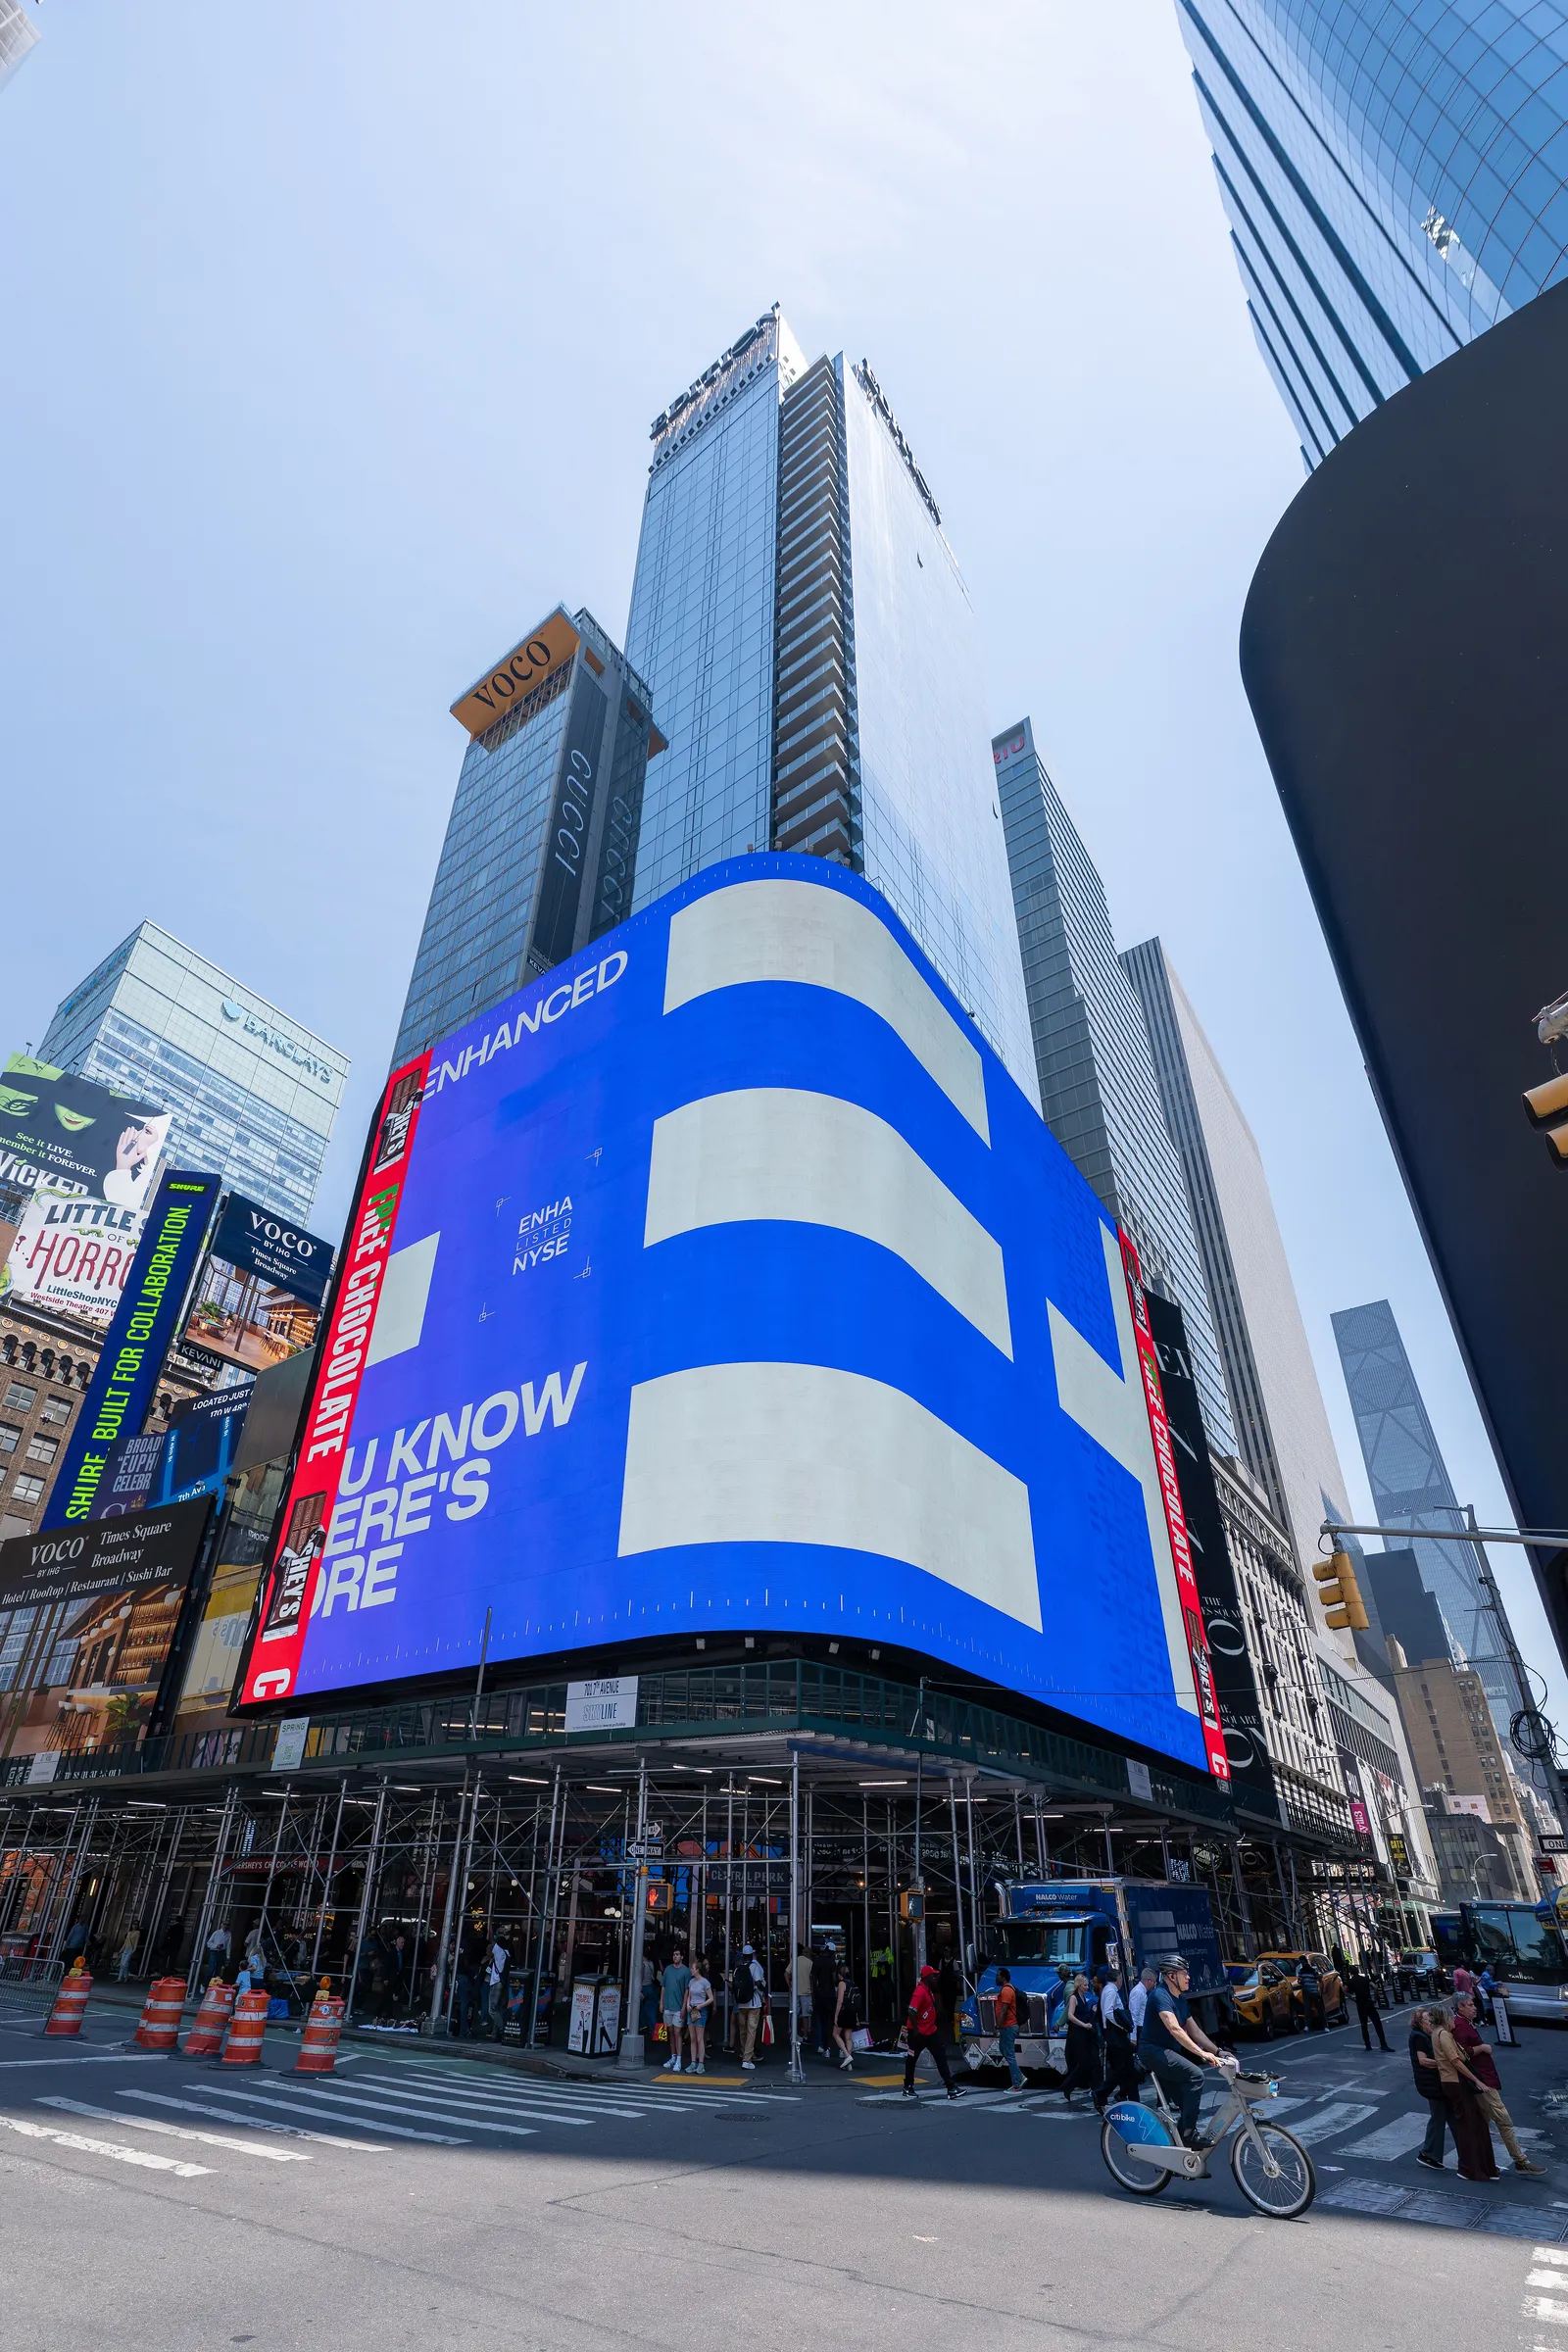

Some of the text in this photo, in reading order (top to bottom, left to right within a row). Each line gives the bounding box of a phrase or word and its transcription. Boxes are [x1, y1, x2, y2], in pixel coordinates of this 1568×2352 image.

[471, 639, 552, 710] VOCO
[555, 749, 593, 877] GUCCI
[423, 950, 629, 1102] ENHANCED
[241, 1011, 335, 1085] BARCLAYS
[16, 1132, 74, 1158] See it LIVE.
[38, 1150, 46, 1159] it
[48, 1153, 98, 1178] FOREVER.
[169, 1183, 206, 1194] SHURE
[44, 1203, 137, 1233] LITTLE
[517, 1196, 573, 1235] ENHA
[107, 1233, 125, 1244] OF
[250, 1210, 314, 1258] VOCO
[263, 1240, 292, 1259] BY IHG
[515, 1217, 572, 1251] LISTED
[251, 1245, 298, 1276] Times Square
[254, 1257, 289, 1281] Broadway
[512, 1234, 570, 1276] NYSE
[30, 1292, 65, 1305] Westside
[66, 1299, 94, 1312] Theatre
[94, 1306, 110, 1315] 407
[91, 1387, 130, 1441] BUILT
[112, 1345, 144, 1383] FOR
[131, 1203, 193, 1345] COLLABORATION.
[307, 1259, 382, 1463] CHOCOLATE
[192, 1389, 252, 1411] LOCATED JUST
[385, 1360, 588, 1484] KNOW
[177, 1492, 190, 1503] 7th
[323, 1457, 491, 1559] ERE'S
[1153, 1414, 1195, 1588] CHOCOLATE
[30, 1521, 172, 1567] VOCO Times Square
[36, 1547, 145, 1579] BY IHG Broadway
[1, 1565, 173, 1605] Hotel Rooftop Restaurant Sushi Bar
[599, 1680, 620, 1695] AVENUE
[583, 1702, 618, 1722] SKYLINE
[630, 1845, 643, 1854] ONE
[1176, 1923, 1215, 1940] NALCO Water
[1121, 2113, 1136, 2123] bike
